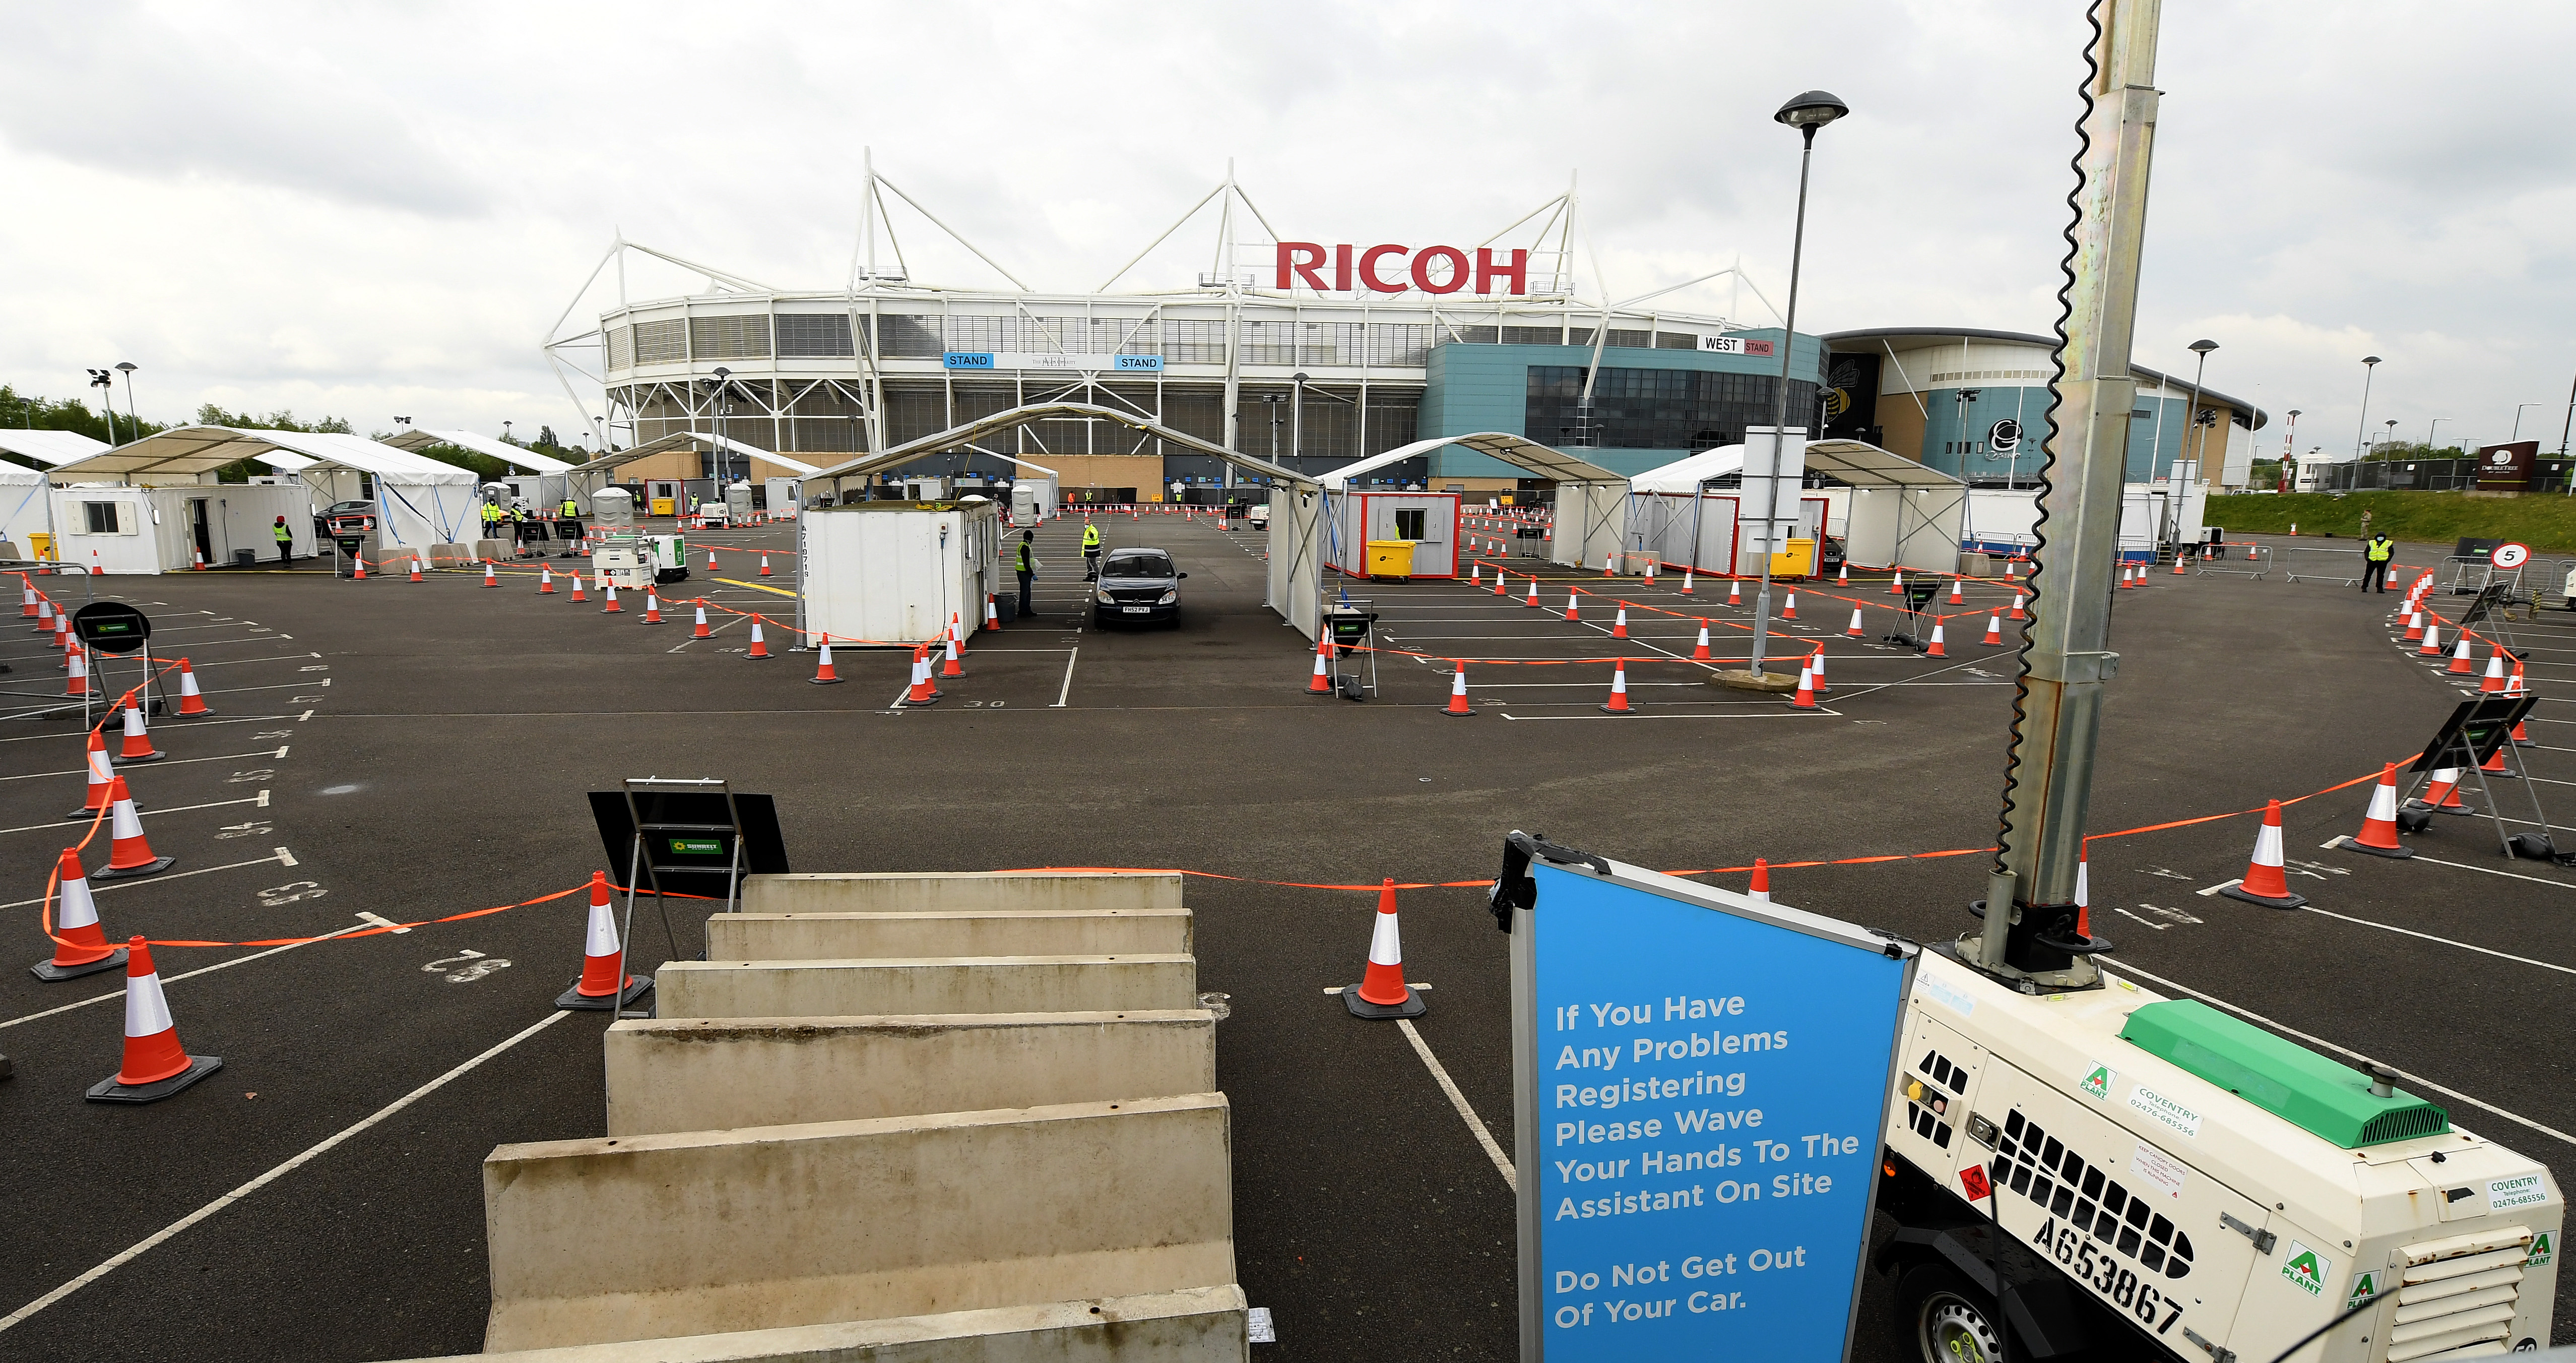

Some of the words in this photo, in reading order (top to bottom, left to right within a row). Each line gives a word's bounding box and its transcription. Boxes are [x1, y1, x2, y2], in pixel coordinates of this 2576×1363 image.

[1276, 241, 1527, 295] RICOH
[1706, 337, 1737, 351] WEST
[1746, 343, 1769, 352] STAND
[949, 356, 987, 365] STAND
[1122, 358, 1157, 367] STAND
[2503, 551, 2516, 561] 5
[1558, 1005, 1579, 1031] If
[1590, 1003, 1651, 1027] You
[1665, 996, 1745, 1021] Have
[1556, 1045, 1621, 1070] Any
[1634, 1031, 1787, 1063] Problems
[1557, 1071, 1745, 1108] Registering
[2081, 1081, 2107, 1098] PLANT
[2140, 1088, 2198, 1121] COVENTRY
[2131, 1099, 2194, 1136] 02476-685556
[2149, 1101, 2181, 1121] Telephone:
[1557, 1119, 1662, 1146] Please
[1675, 1109, 1763, 1134] Wave
[1555, 1159, 1630, 1183] Your
[1643, 1144, 1741, 1174] Hands
[1754, 1140, 1789, 1162] To
[1801, 1133, 1858, 1158] The
[2136, 1156, 2150, 1167] WHEN
[2150, 1165, 2159, 1173] THIS
[2160, 1172, 2180, 1187] MACHINE
[2149, 1152, 2168, 1165] CANOPY
[2169, 1163, 2185, 1175] DOORS
[2151, 1160, 2168, 1172] CLOSED
[2148, 1170, 2169, 1186] RUNNING
[2491, 1176, 2537, 1191] COVENTRY
[1555, 1185, 1703, 1221] Assistant
[1716, 1181, 1760, 1203] On
[1772, 1173, 1832, 1197] Site
[2493, 1193, 2545, 1208] 02476-685556
[1556, 1271, 1599, 1293] Do
[1613, 1261, 1669, 1287] Not
[1682, 1254, 1736, 1278] Get
[1749, 1246, 1806, 1271] Out
[2033, 1216, 2183, 1335] A653867
[2282, 1266, 2321, 1295] PLANT
[1555, 1307, 1593, 1328] Of
[1604, 1299, 1676, 1322] Your
[1688, 1291, 1746, 1313] Car.
